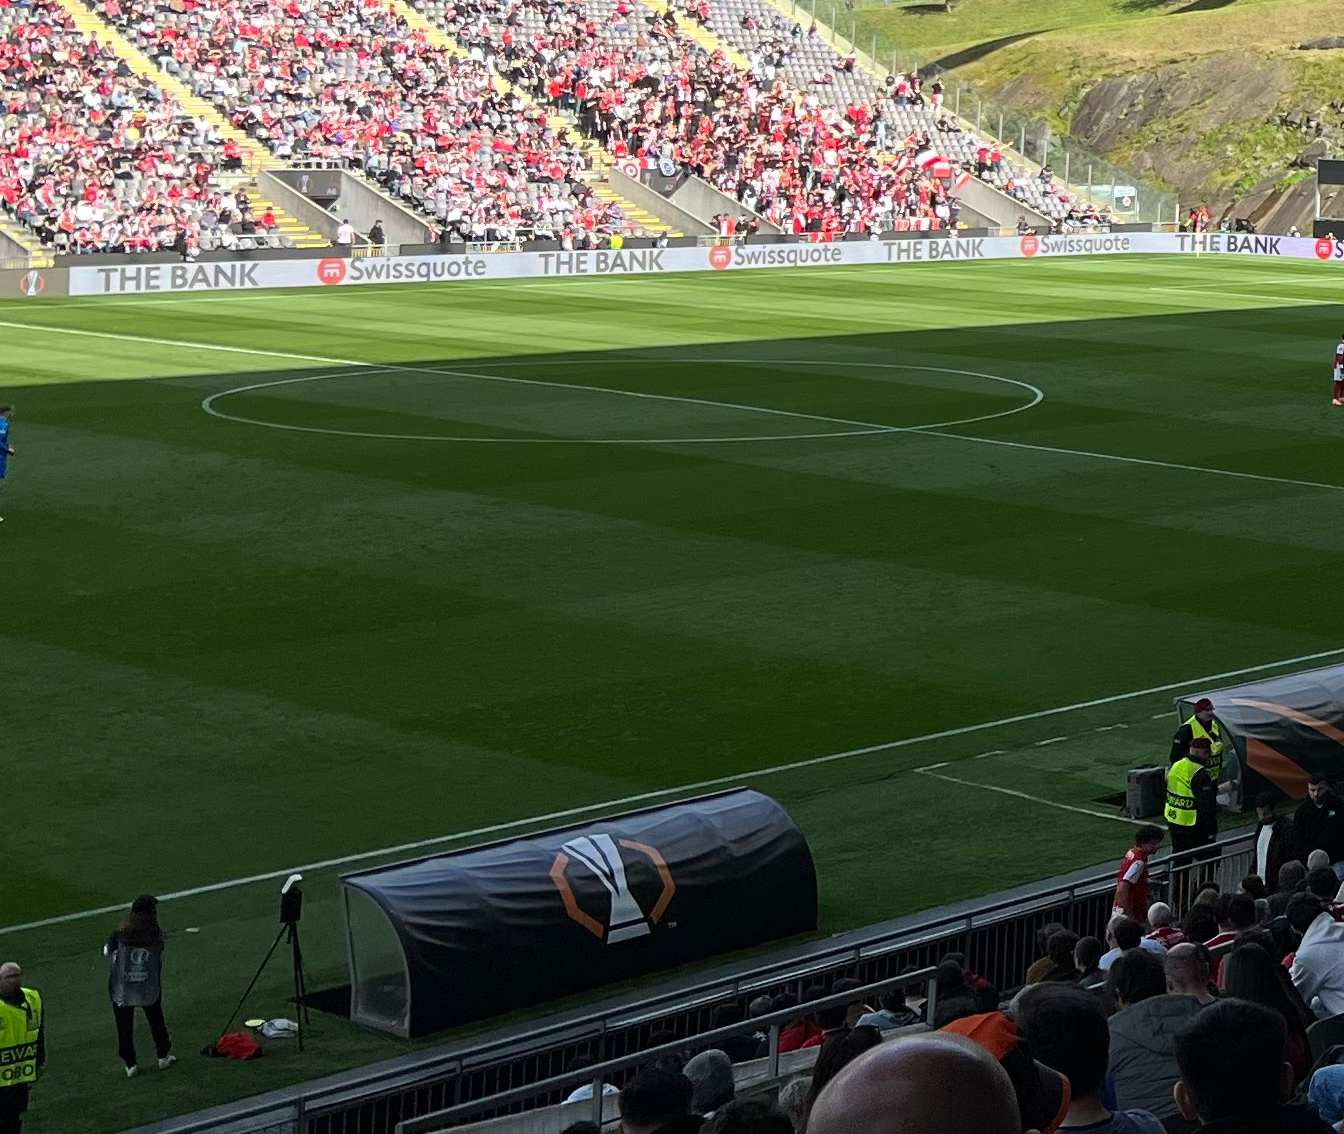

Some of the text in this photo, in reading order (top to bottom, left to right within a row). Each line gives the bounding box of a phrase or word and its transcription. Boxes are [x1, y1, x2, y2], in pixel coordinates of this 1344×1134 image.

[734, 245, 842, 266] Swissquote
[883, 239, 984, 261] THE BANK
[1041, 235, 1130, 254] Swissquote
[1175, 234, 1282, 255] THE BANK
[350, 256, 487, 281] Swissquote
[538, 250, 665, 274] THE BANK
[97, 263, 260, 292] THE BANK
